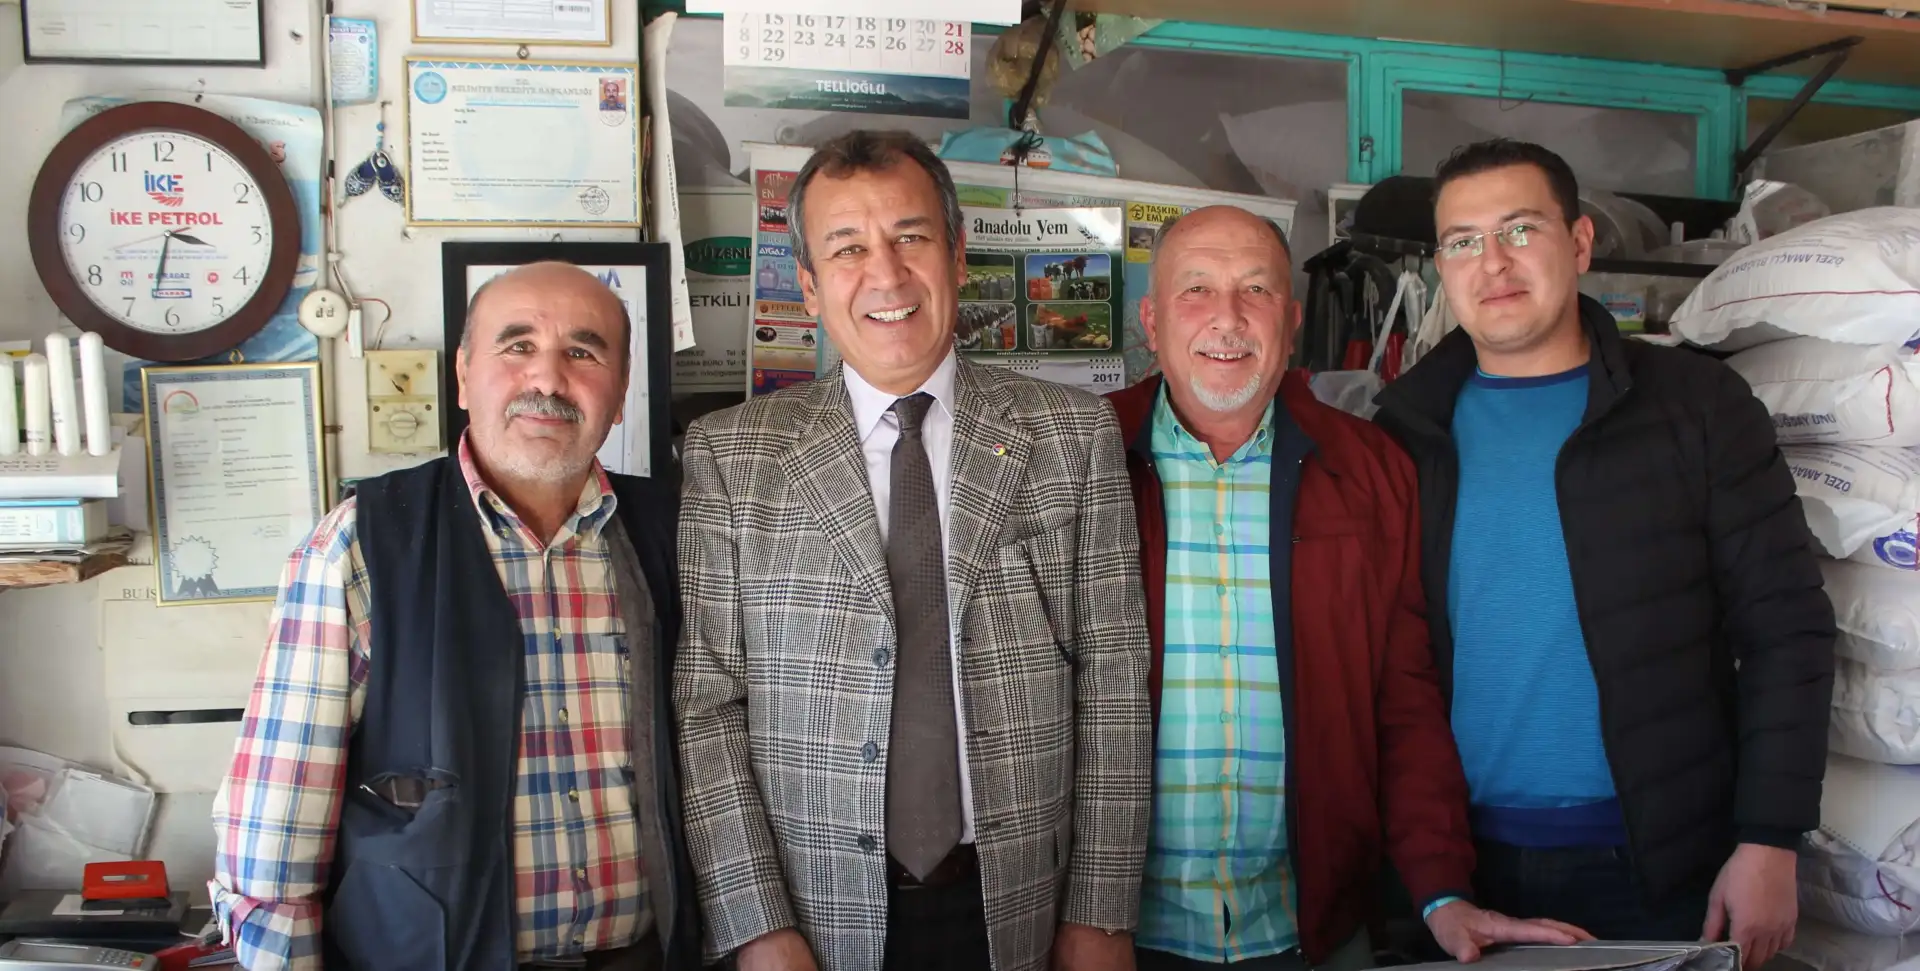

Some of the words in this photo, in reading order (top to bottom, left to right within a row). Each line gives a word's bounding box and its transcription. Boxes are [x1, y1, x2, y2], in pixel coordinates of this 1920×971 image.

[795, 14, 815, 28] 16
[826, 15, 845, 29] 17
[856, 16, 876, 31] 18
[887, 18, 906, 33] 19
[915, 20, 936, 35] 20
[944, 22, 964, 38] 21
[739, 28, 750, 42] 8
[763, 29, 785, 44] 22
[794, 31, 815, 46] 23
[824, 33, 846, 47] 24
[855, 34, 876, 49] 25
[885, 36, 907, 51] 26
[915, 38, 936, 53] 27
[944, 40, 965, 56] 28
[740, 45, 750, 60] 9
[763, 47, 785, 62] 29
[815, 79, 886, 95] TELLİOĞLU
[111, 151, 127, 173] 11
[152, 140, 175, 163] 12
[206, 151, 213, 173] 1
[79, 181, 104, 203] 10
[144, 170, 184, 192] İKE
[233, 182, 249, 204] 2
[110, 208, 143, 226] İKE
[148, 211, 223, 226] PETROL
[69, 223, 86, 245] 9
[250, 225, 262, 246] 3
[758, 246, 786, 256] AYGAZ
[1816, 253, 1845, 268] ÖZEL
[87, 264, 103, 287] 8
[232, 265, 251, 286] 4
[122, 296, 137, 318] 7
[211, 296, 225, 319] 5
[689, 292, 741, 307] ETKİLİ
[164, 305, 181, 327] 6
[1092, 373, 1120, 383] 2017
[1787, 463, 1822, 482] AMAÇ
[1823, 473, 1852, 496] ÖZEL
